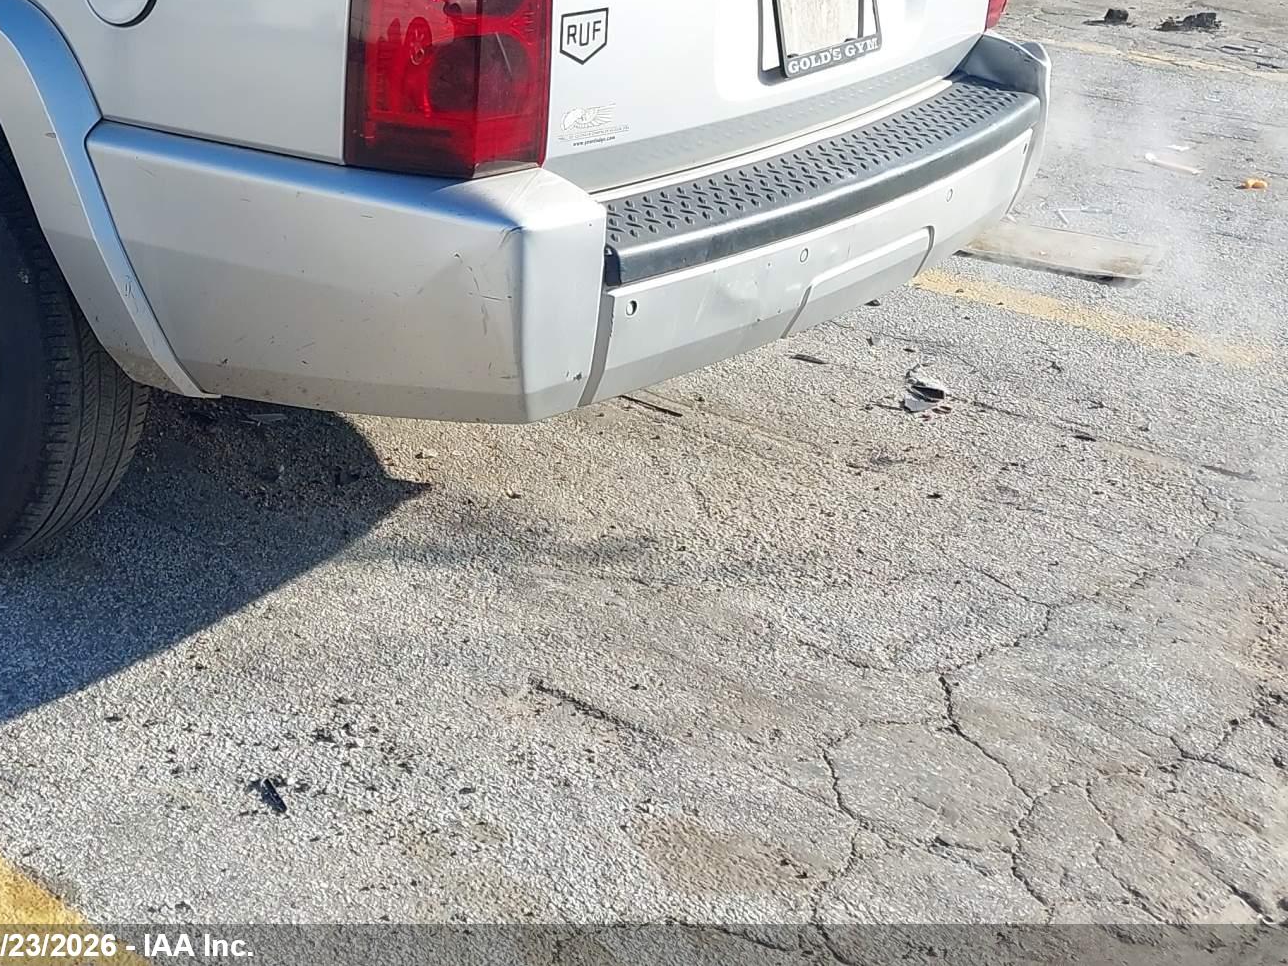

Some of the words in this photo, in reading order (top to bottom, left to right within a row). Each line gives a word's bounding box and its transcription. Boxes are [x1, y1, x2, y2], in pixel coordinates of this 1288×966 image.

[567, 19, 601, 47] RUF
[788, 47, 842, 74] GOLD'S
[844, 37, 880, 57] GYM
